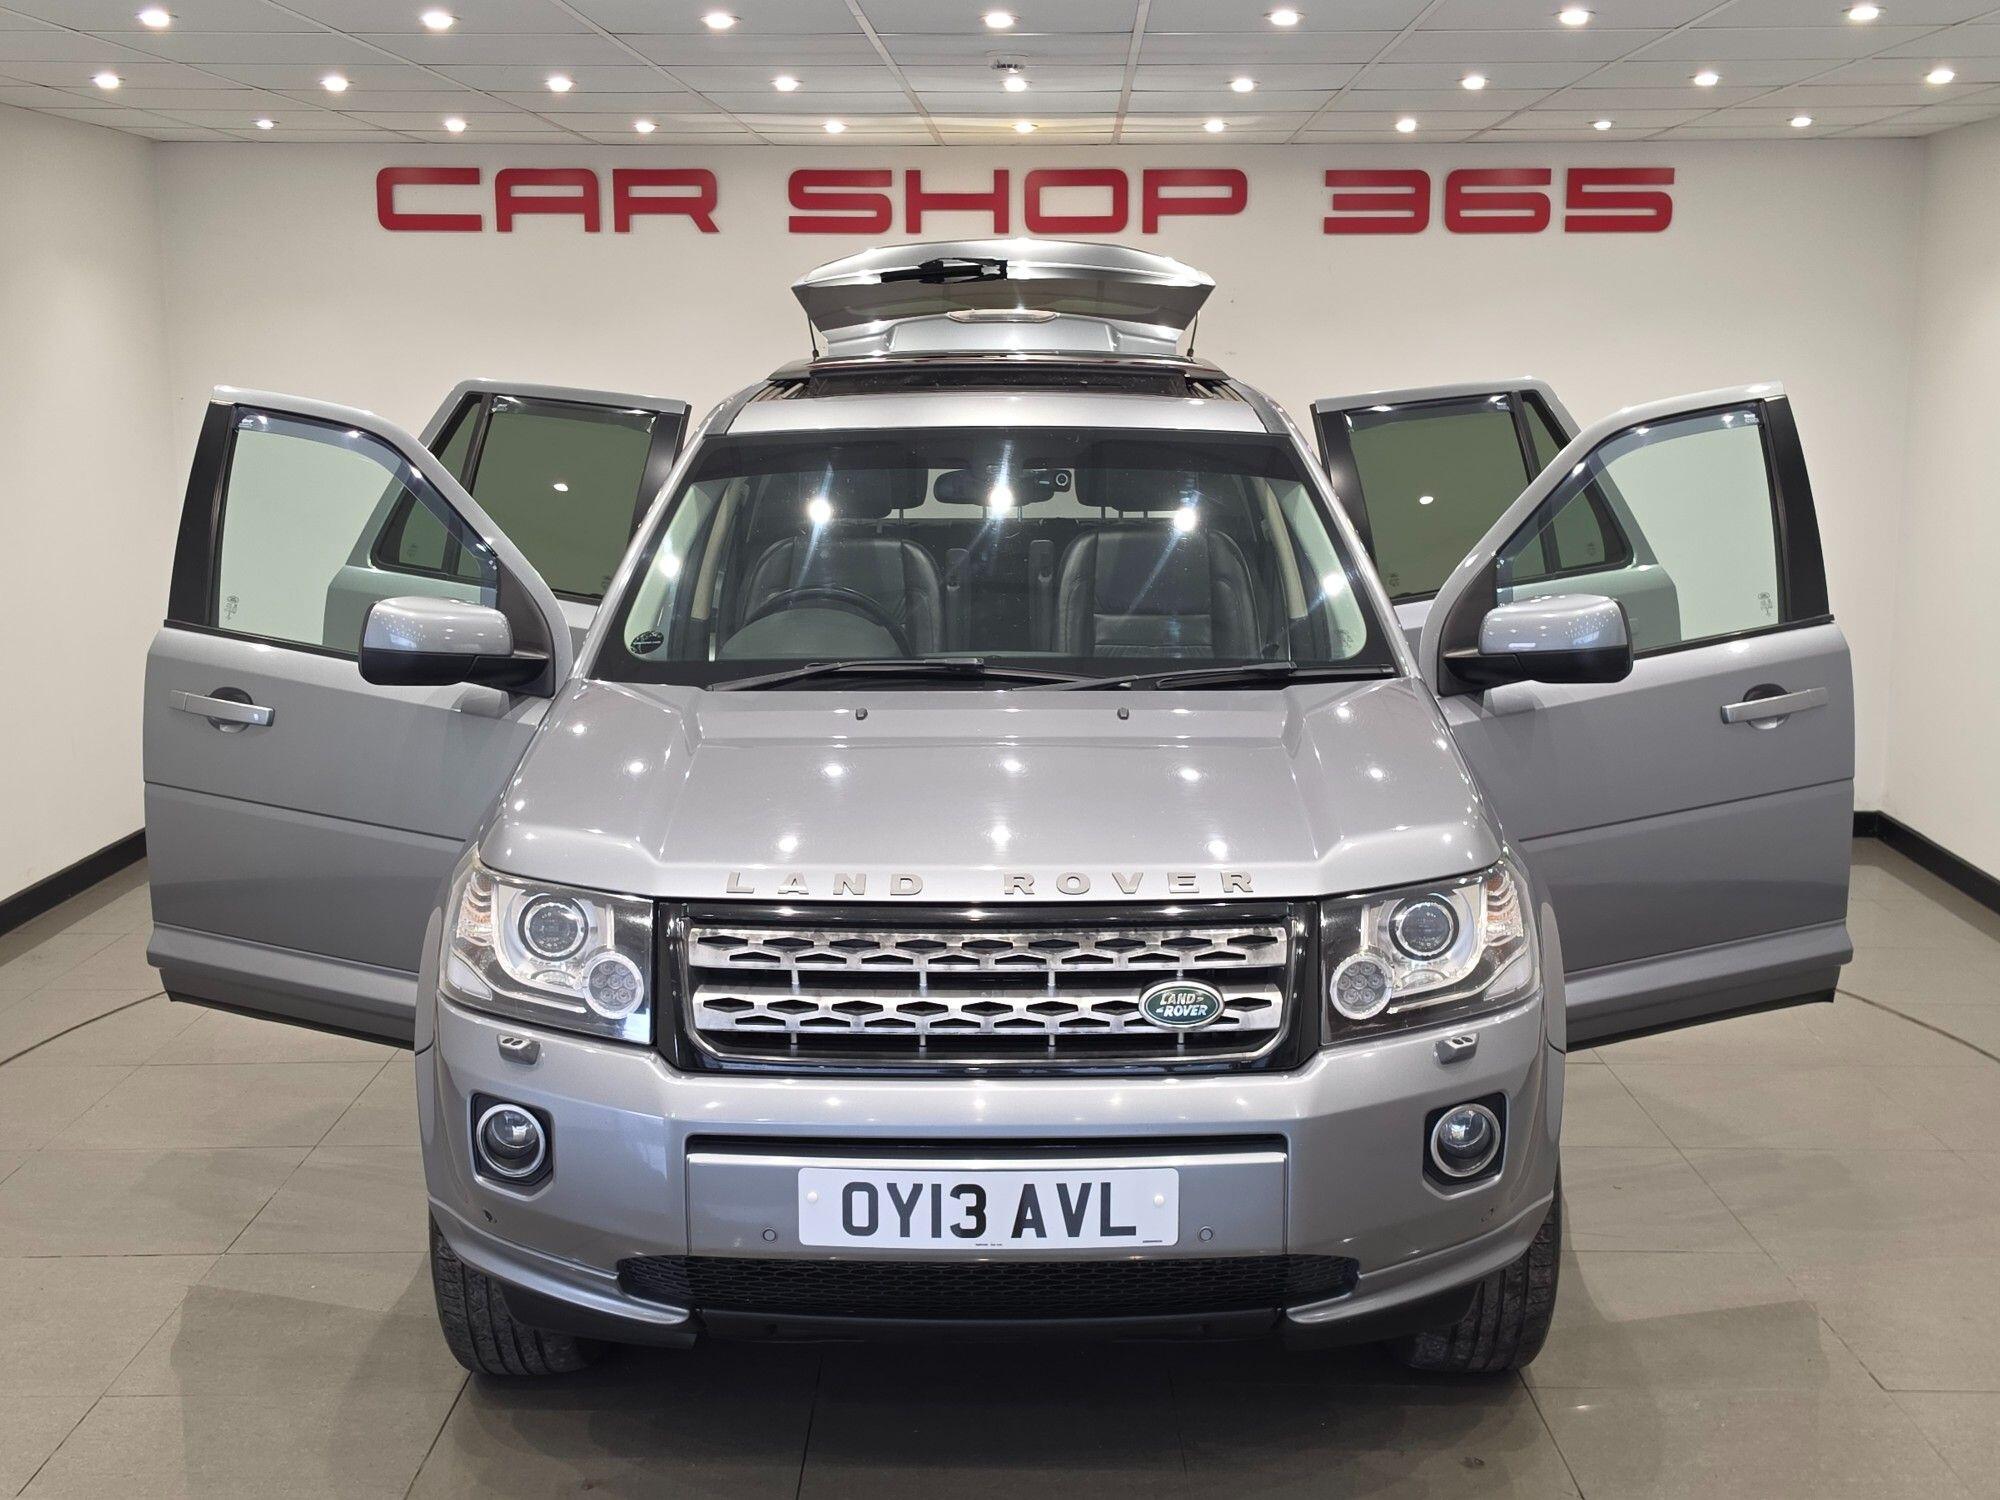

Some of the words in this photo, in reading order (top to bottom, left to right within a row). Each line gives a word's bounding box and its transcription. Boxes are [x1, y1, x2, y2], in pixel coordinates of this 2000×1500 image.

[376, 167, 718, 234] CAR
[788, 168, 1248, 235] SHOP
[1323, 167, 1675, 235] 365
[726, 871, 924, 896] LAND
[1004, 871, 1255, 895] ROVER
[1159, 992, 1196, 1006] LAND
[1163, 1004, 1209, 1017] ROVER
[841, 1181, 988, 1239] OY13
[1010, 1182, 1137, 1239] AVL
